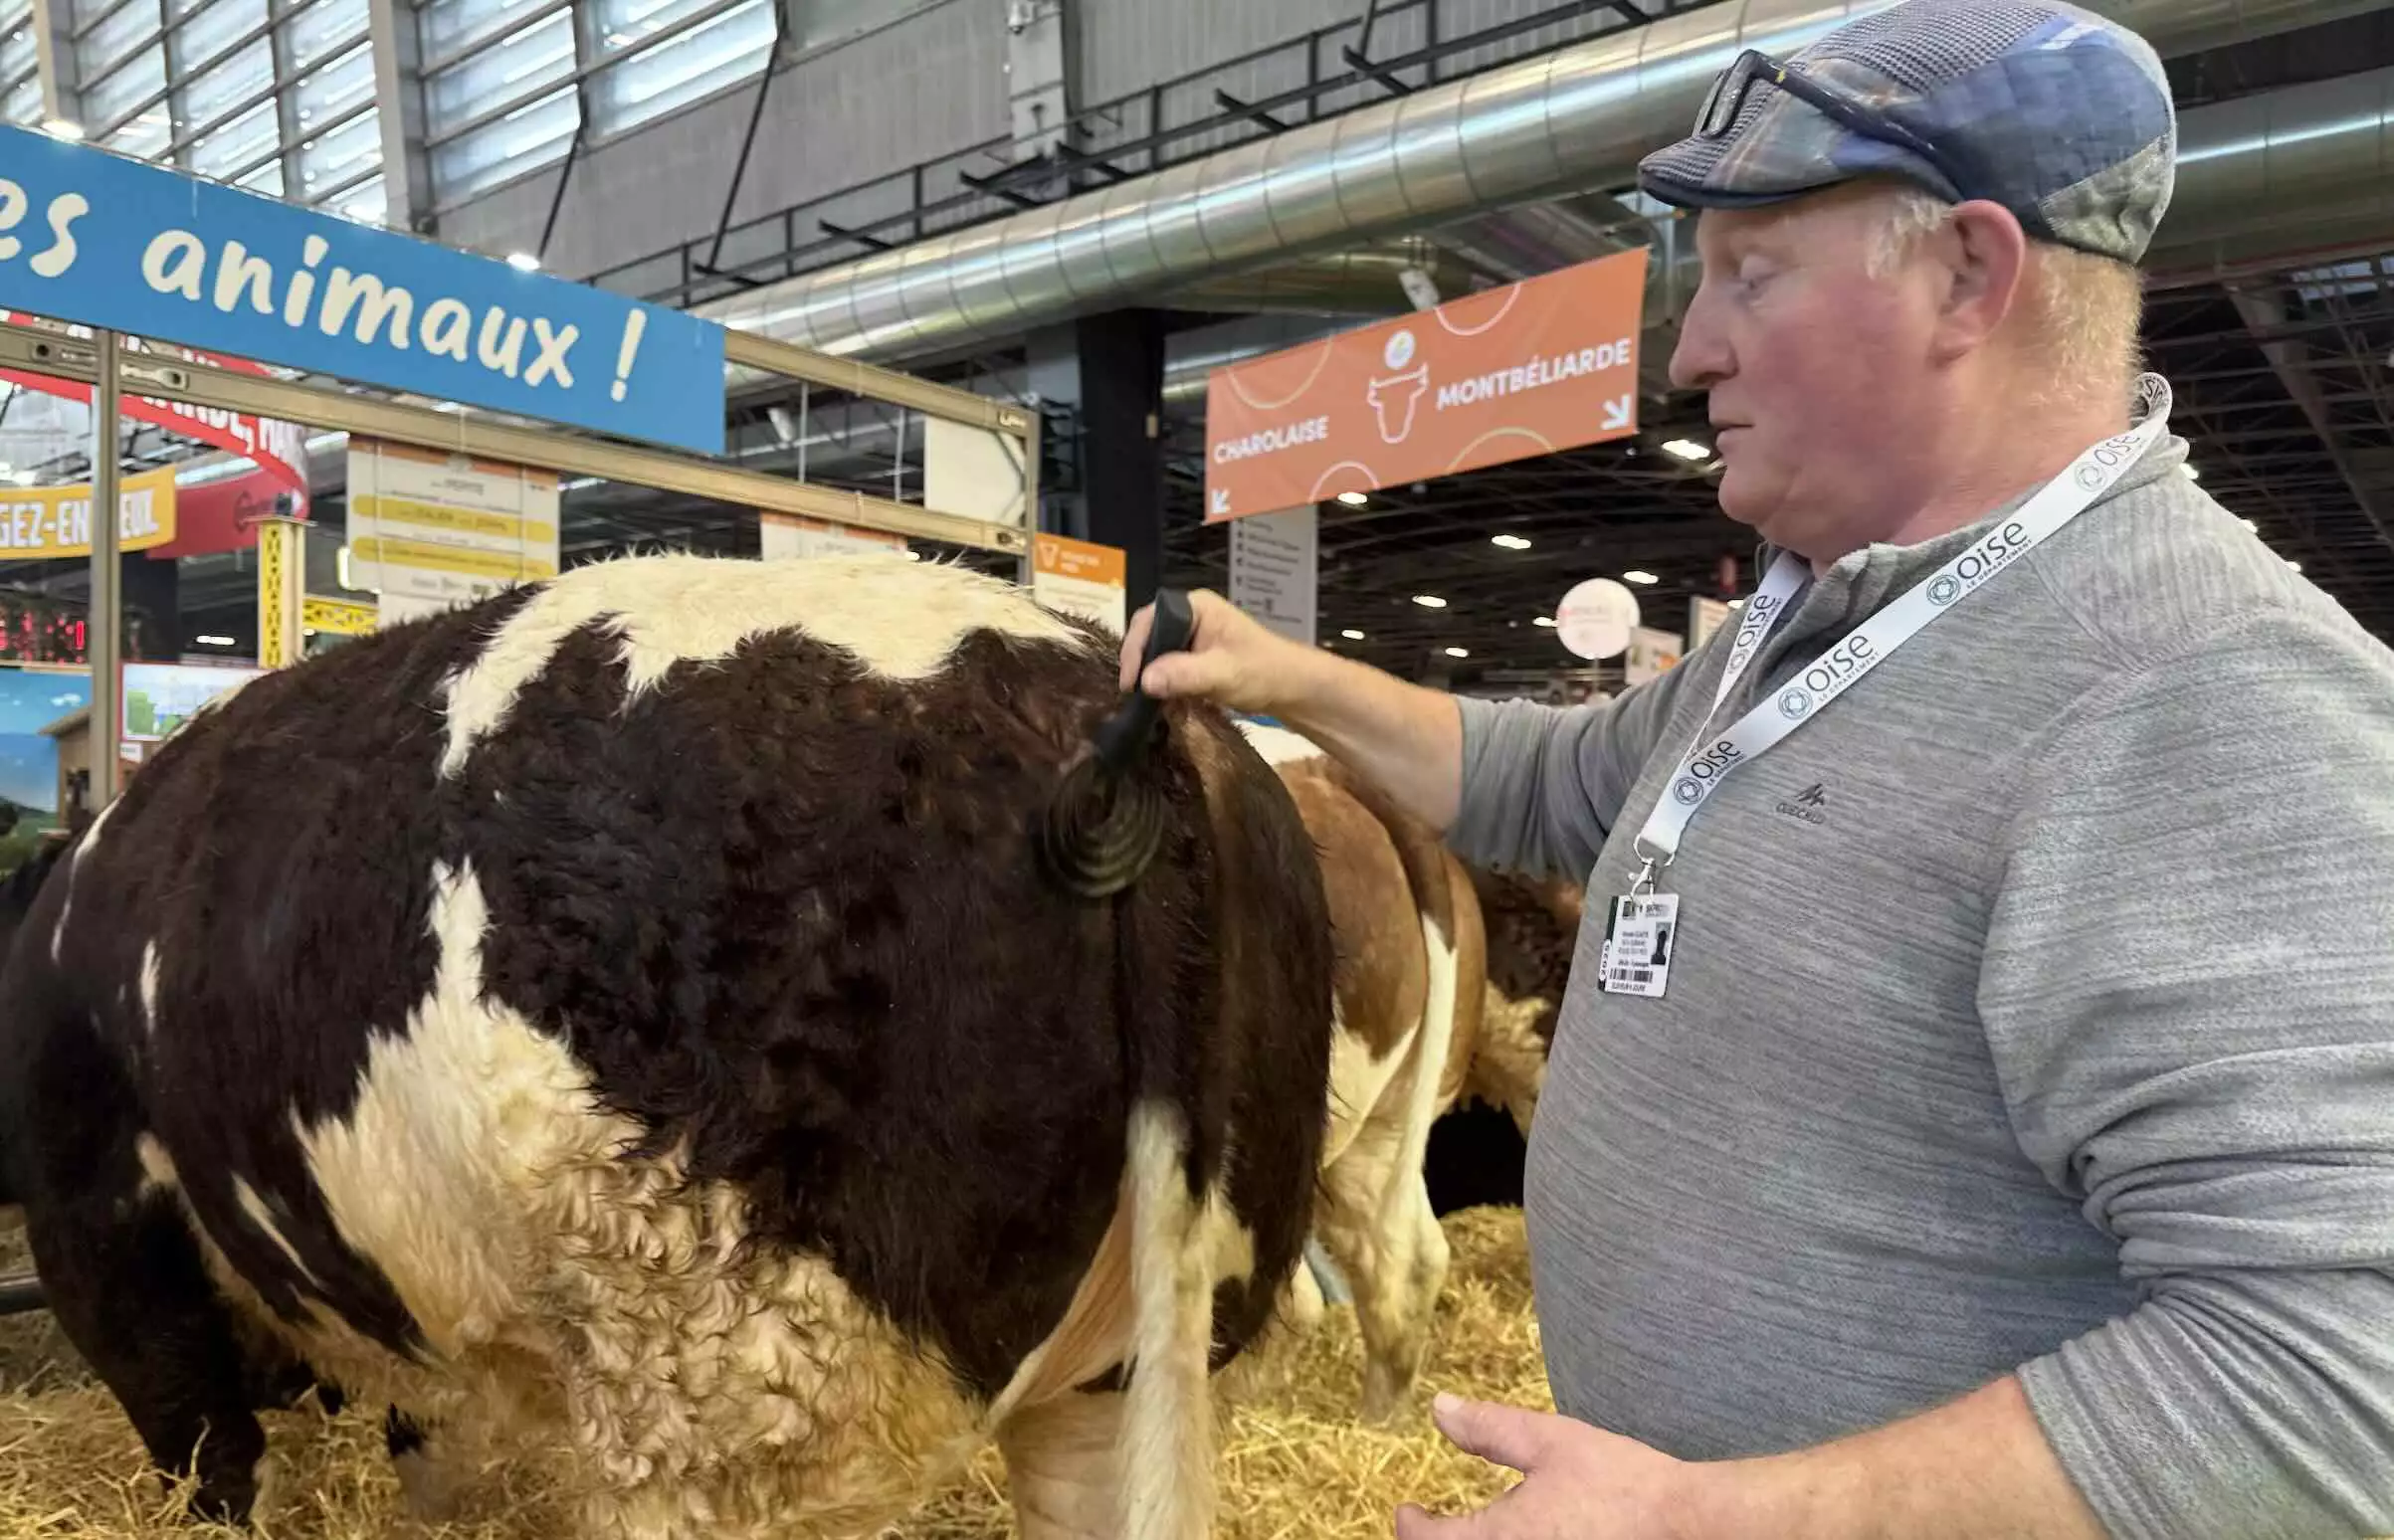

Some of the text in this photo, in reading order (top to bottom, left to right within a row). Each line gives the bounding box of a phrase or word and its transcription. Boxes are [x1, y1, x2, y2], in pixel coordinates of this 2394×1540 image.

[142, 229, 579, 389] animaux
[610, 308, 647, 403] !
[1436, 338, 1632, 411] MONTBÉLIARDE
[1213, 415, 1329, 464] CHAROLAISE
